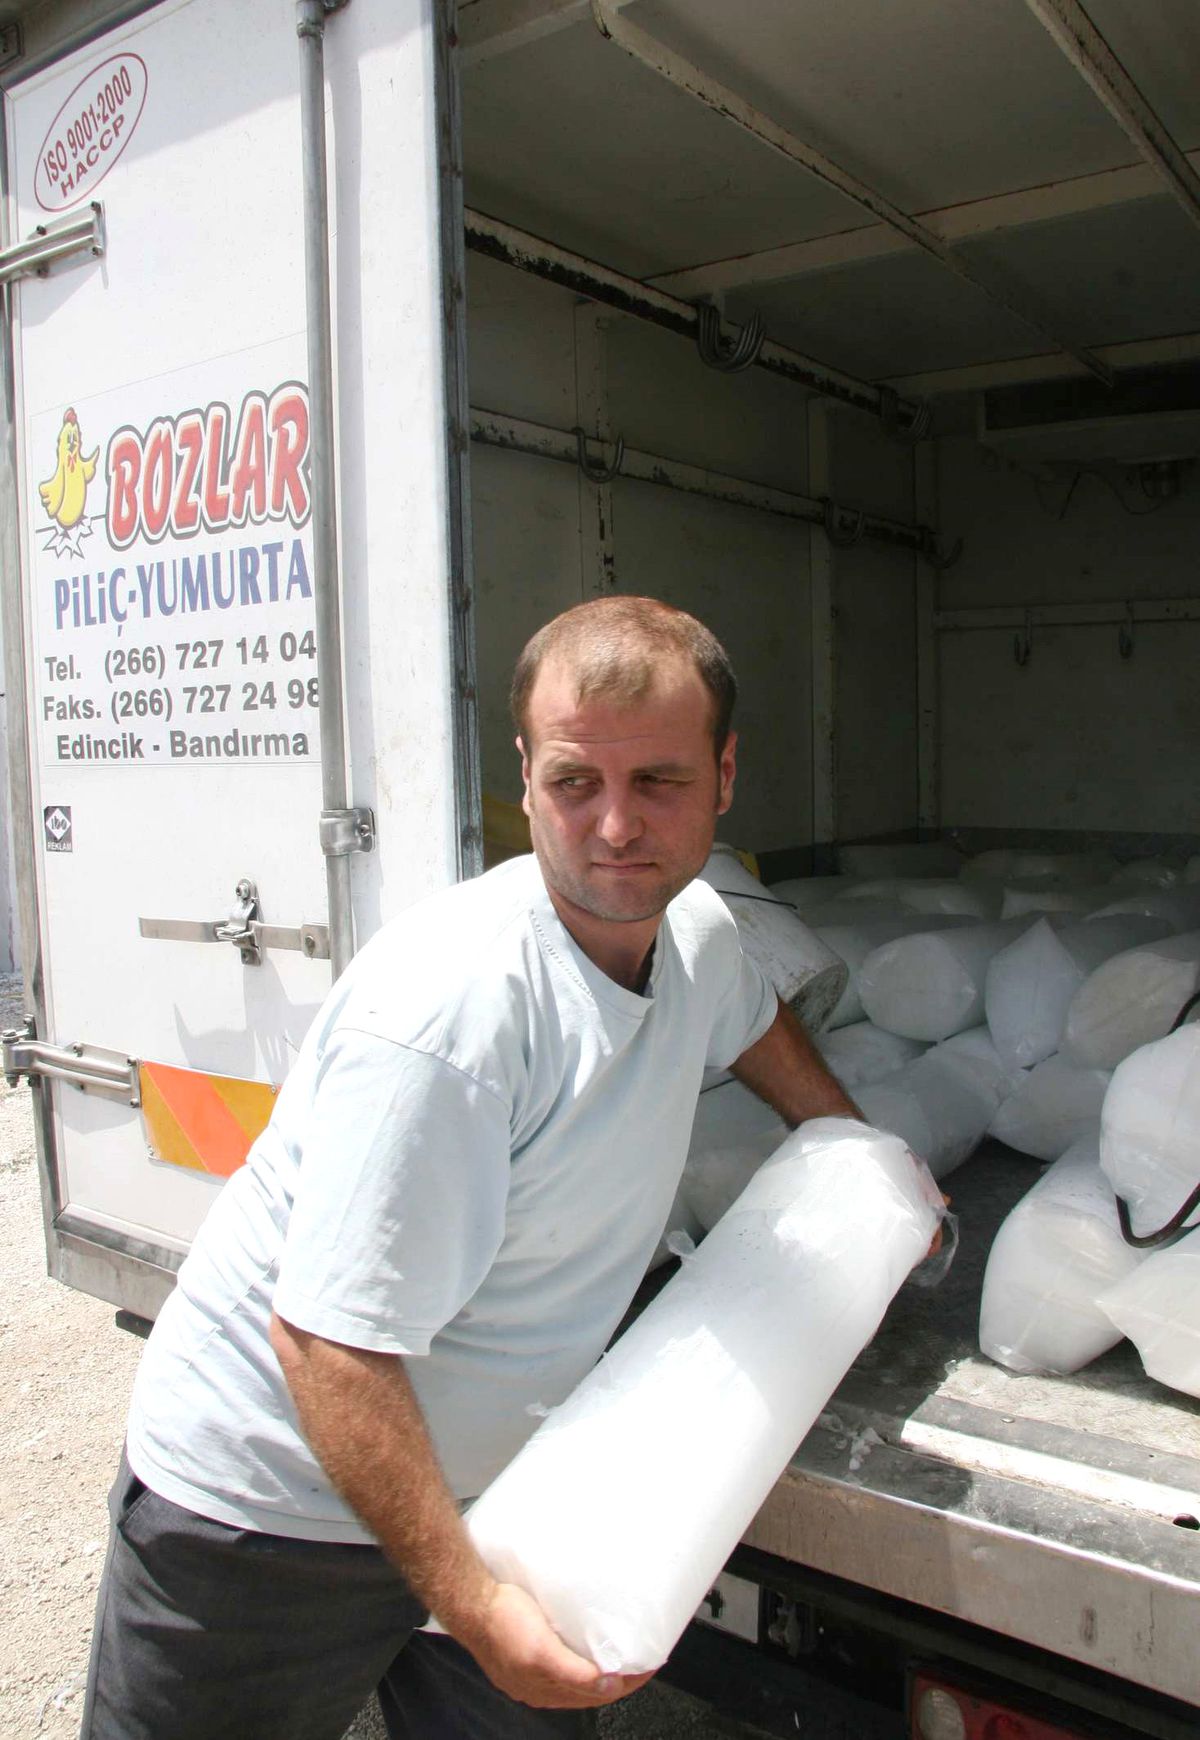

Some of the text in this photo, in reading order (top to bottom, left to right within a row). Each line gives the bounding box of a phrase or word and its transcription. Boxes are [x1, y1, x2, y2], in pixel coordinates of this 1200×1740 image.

[43, 139, 68, 187] ISO
[60, 114, 125, 198] HACCP
[105, 380, 312, 551] BOZLAR
[44, 630, 317, 684] Tel. (266) 727 14 04
[43, 677, 320, 724] Faks. (266) 727 24 98
[56, 732, 145, 760] Edincik
[169, 728, 309, 758] Bandırma
